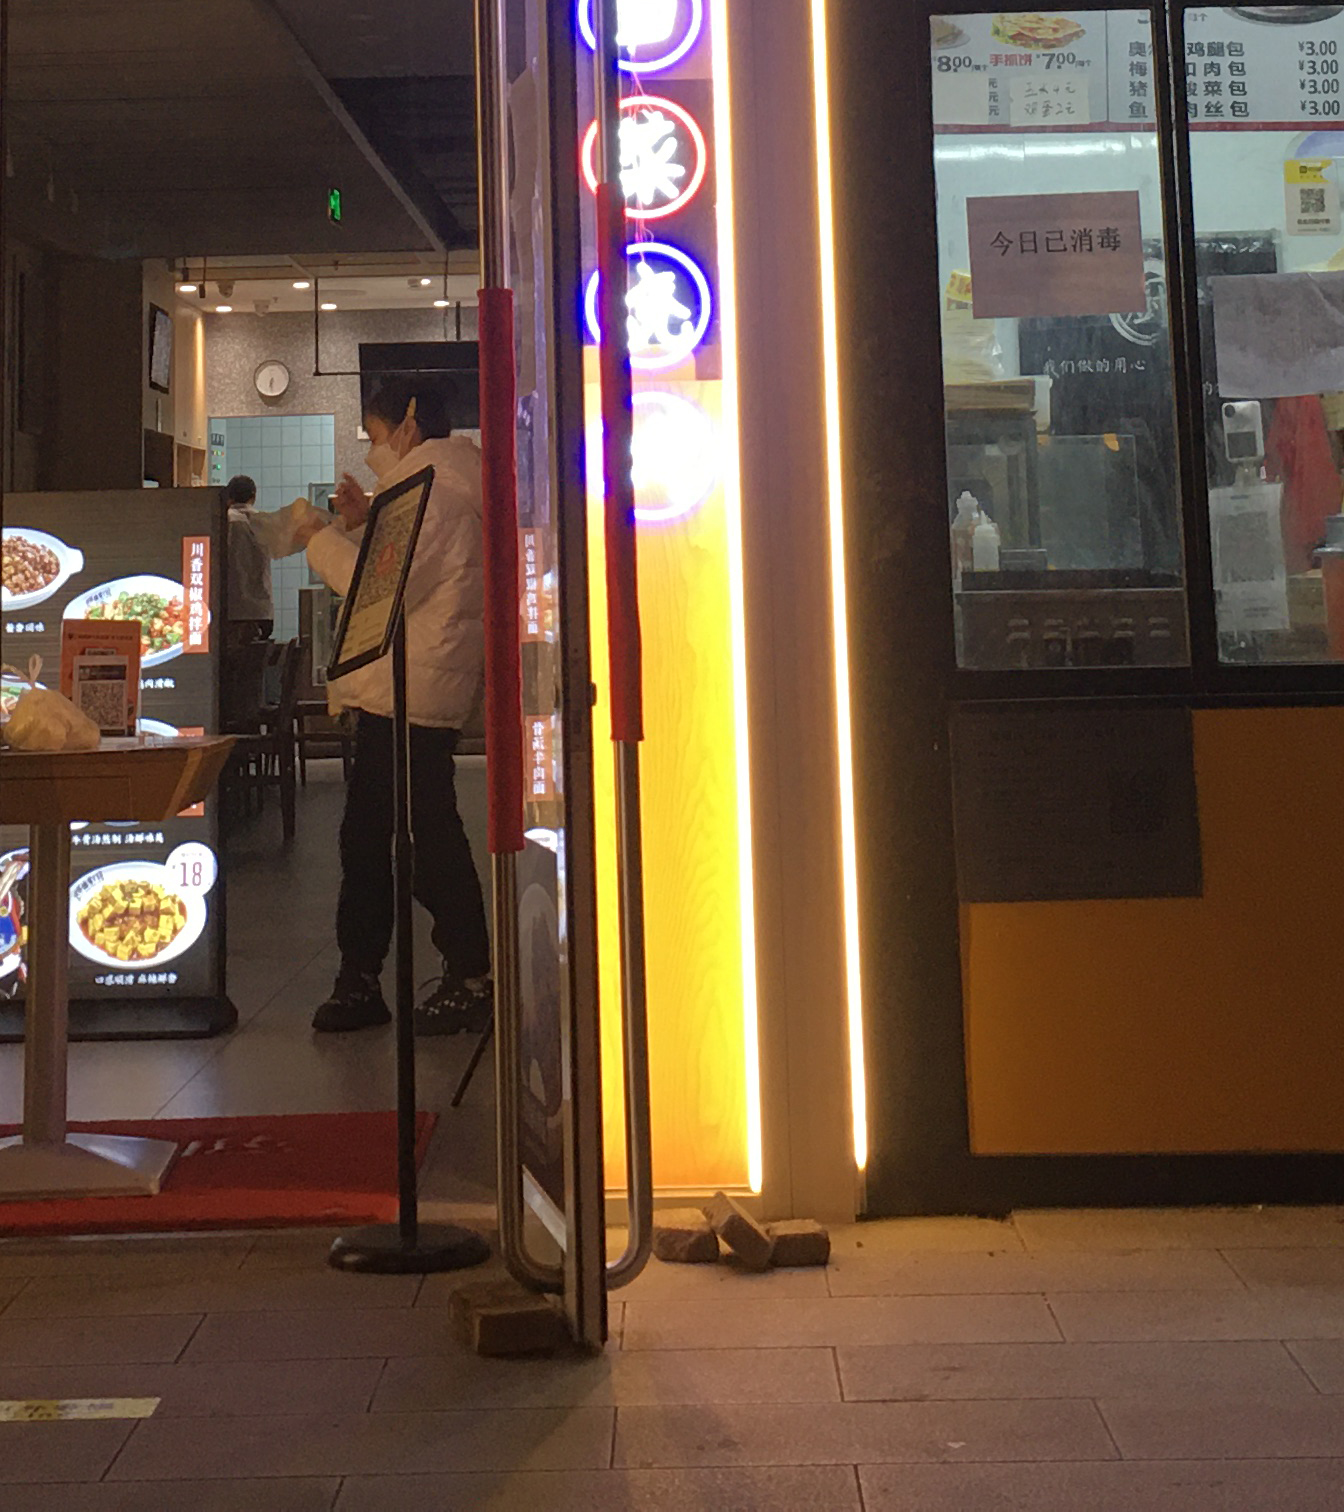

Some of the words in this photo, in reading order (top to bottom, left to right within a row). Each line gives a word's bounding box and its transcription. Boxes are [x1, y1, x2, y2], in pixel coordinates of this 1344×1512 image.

[989, 53, 1033, 68] 手抓饼
[989, 227, 1122, 256] 今日已消毒
